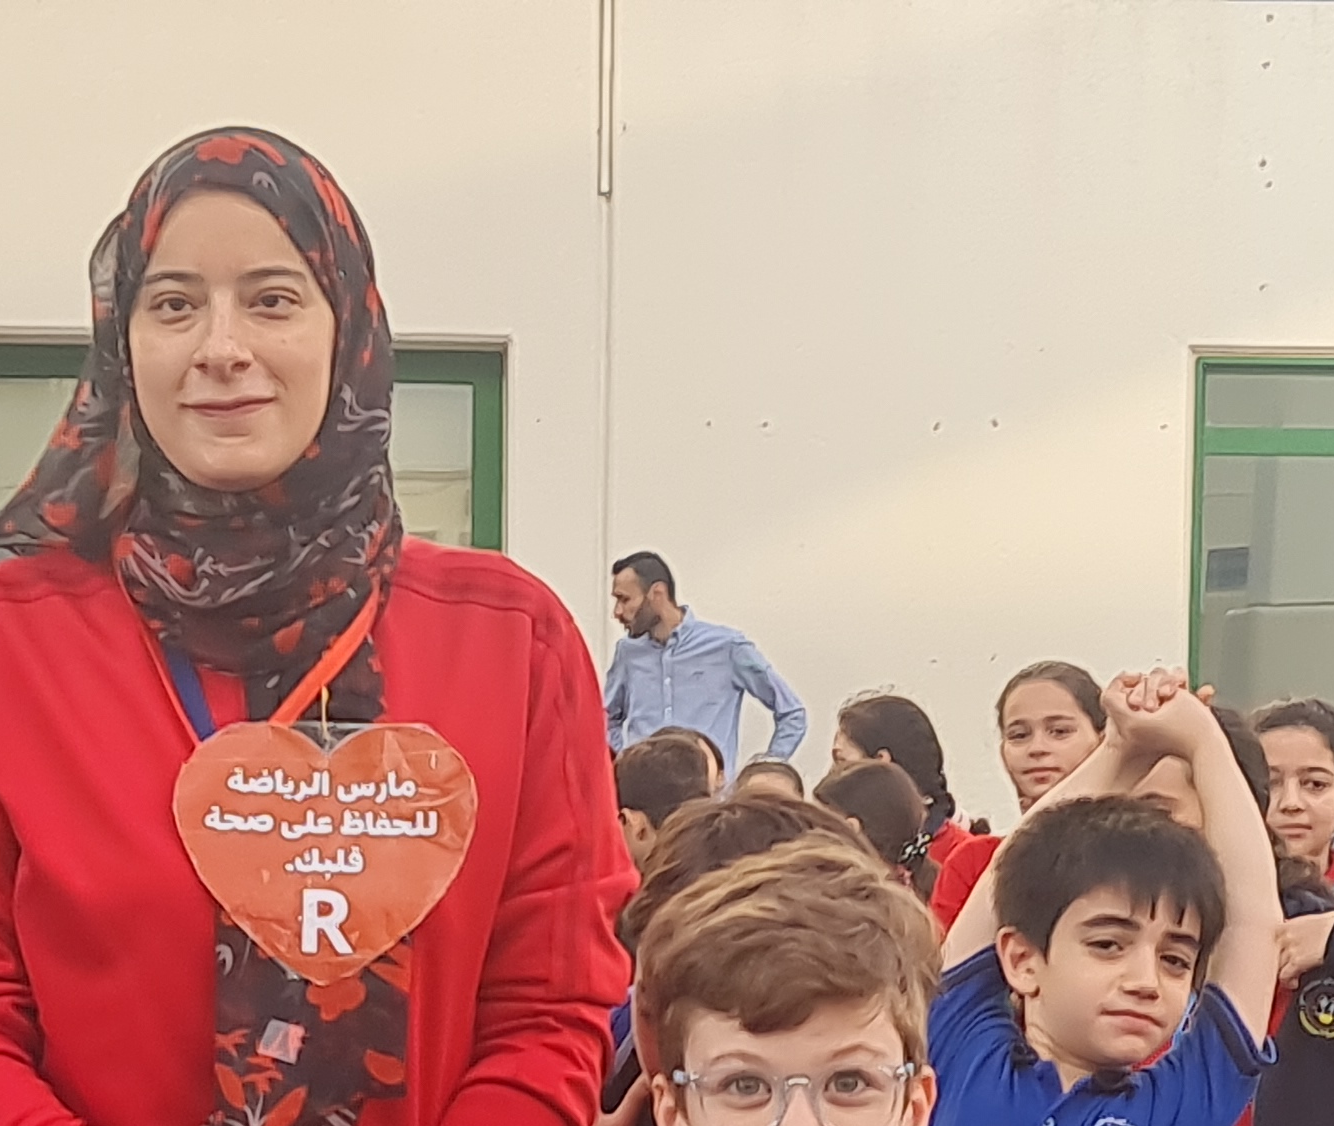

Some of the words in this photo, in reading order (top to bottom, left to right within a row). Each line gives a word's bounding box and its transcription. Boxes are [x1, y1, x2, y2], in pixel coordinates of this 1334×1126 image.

[226, 766, 330, 803] الرياضة
[337, 770, 416, 803] مارس
[203, 805, 275, 833] صحة
[279, 809, 334, 840] على
[339, 808, 438, 837] للحفاظ
[284, 845, 364, 880] قلبك.
[300, 887, 354, 955] R
